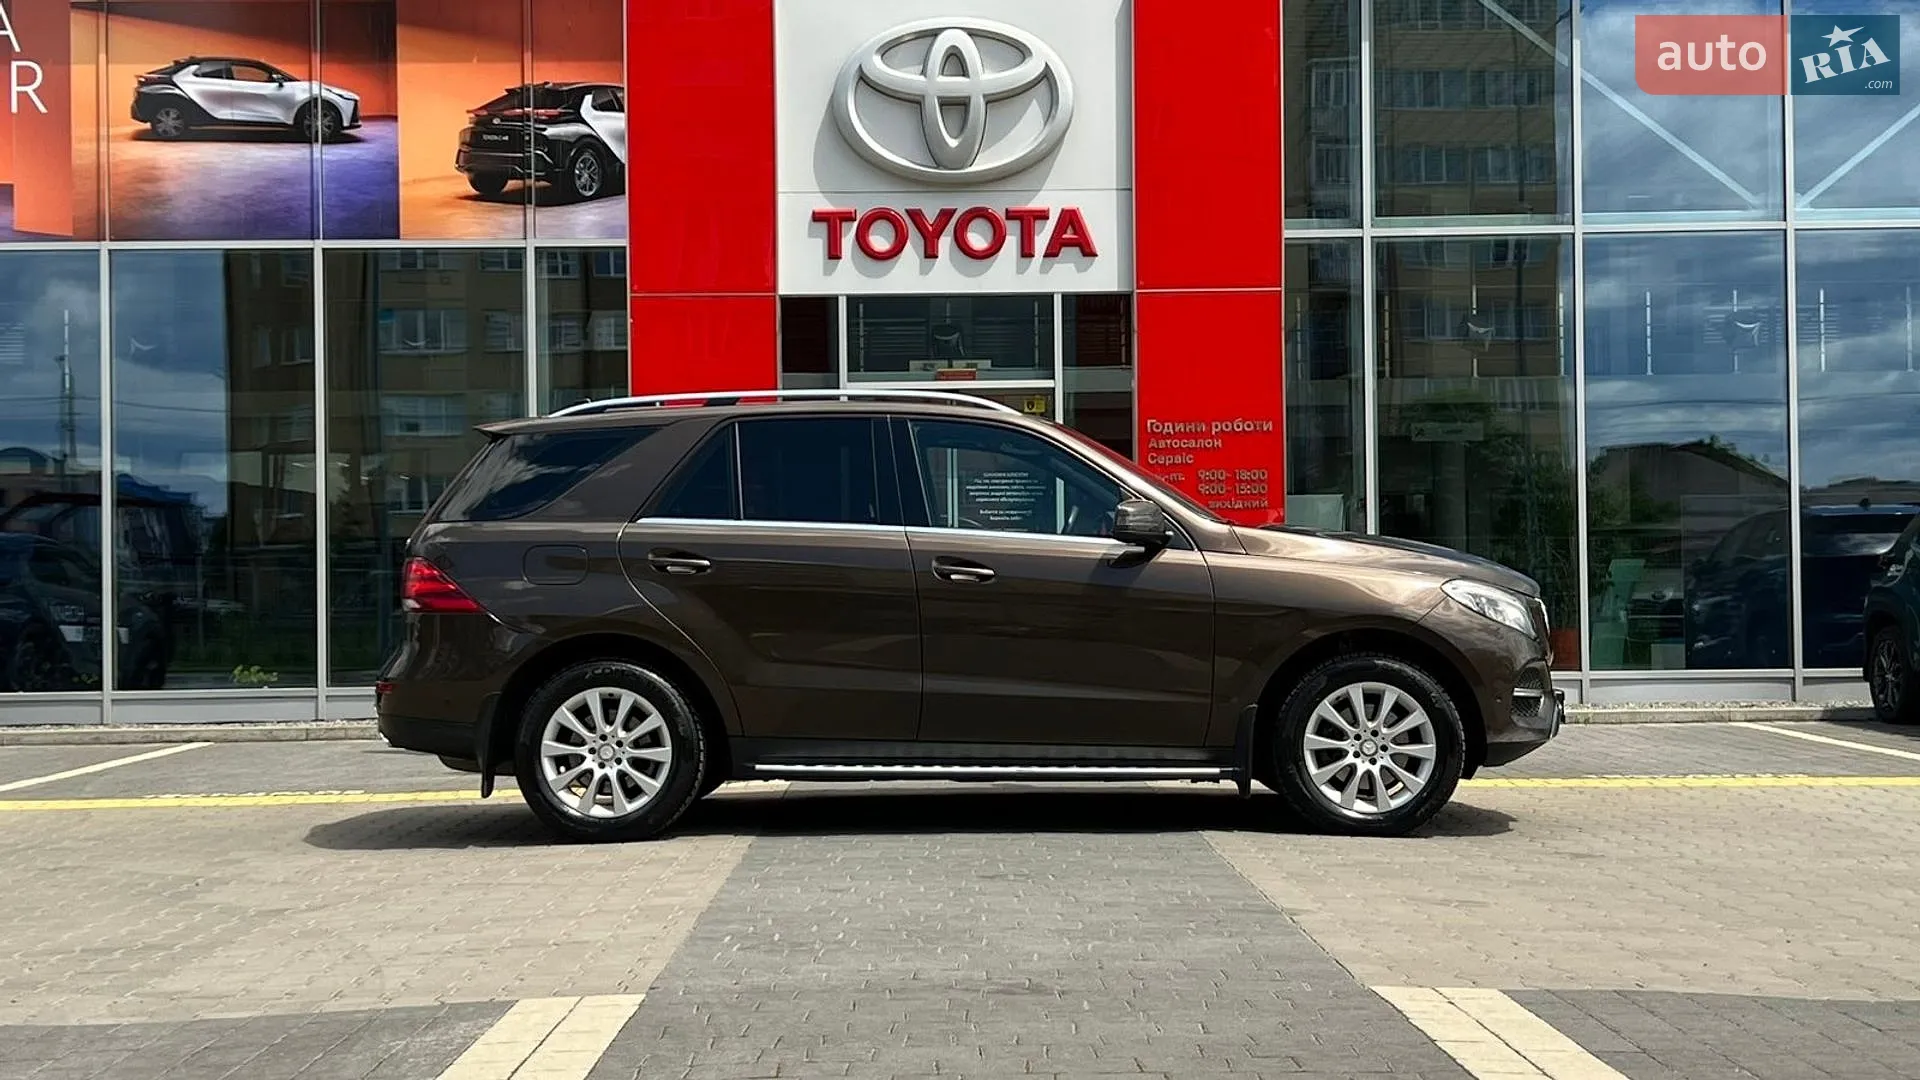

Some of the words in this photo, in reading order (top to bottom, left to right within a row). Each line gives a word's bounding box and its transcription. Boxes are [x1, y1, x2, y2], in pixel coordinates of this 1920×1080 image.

[811, 207, 1098, 260] TOYOTA
[1147, 418, 1206, 434] Години
[1211, 418, 1273, 435] роботи
[1148, 437, 1222, 449] Автосалон
[1148, 452, 1194, 466] Сервіс
